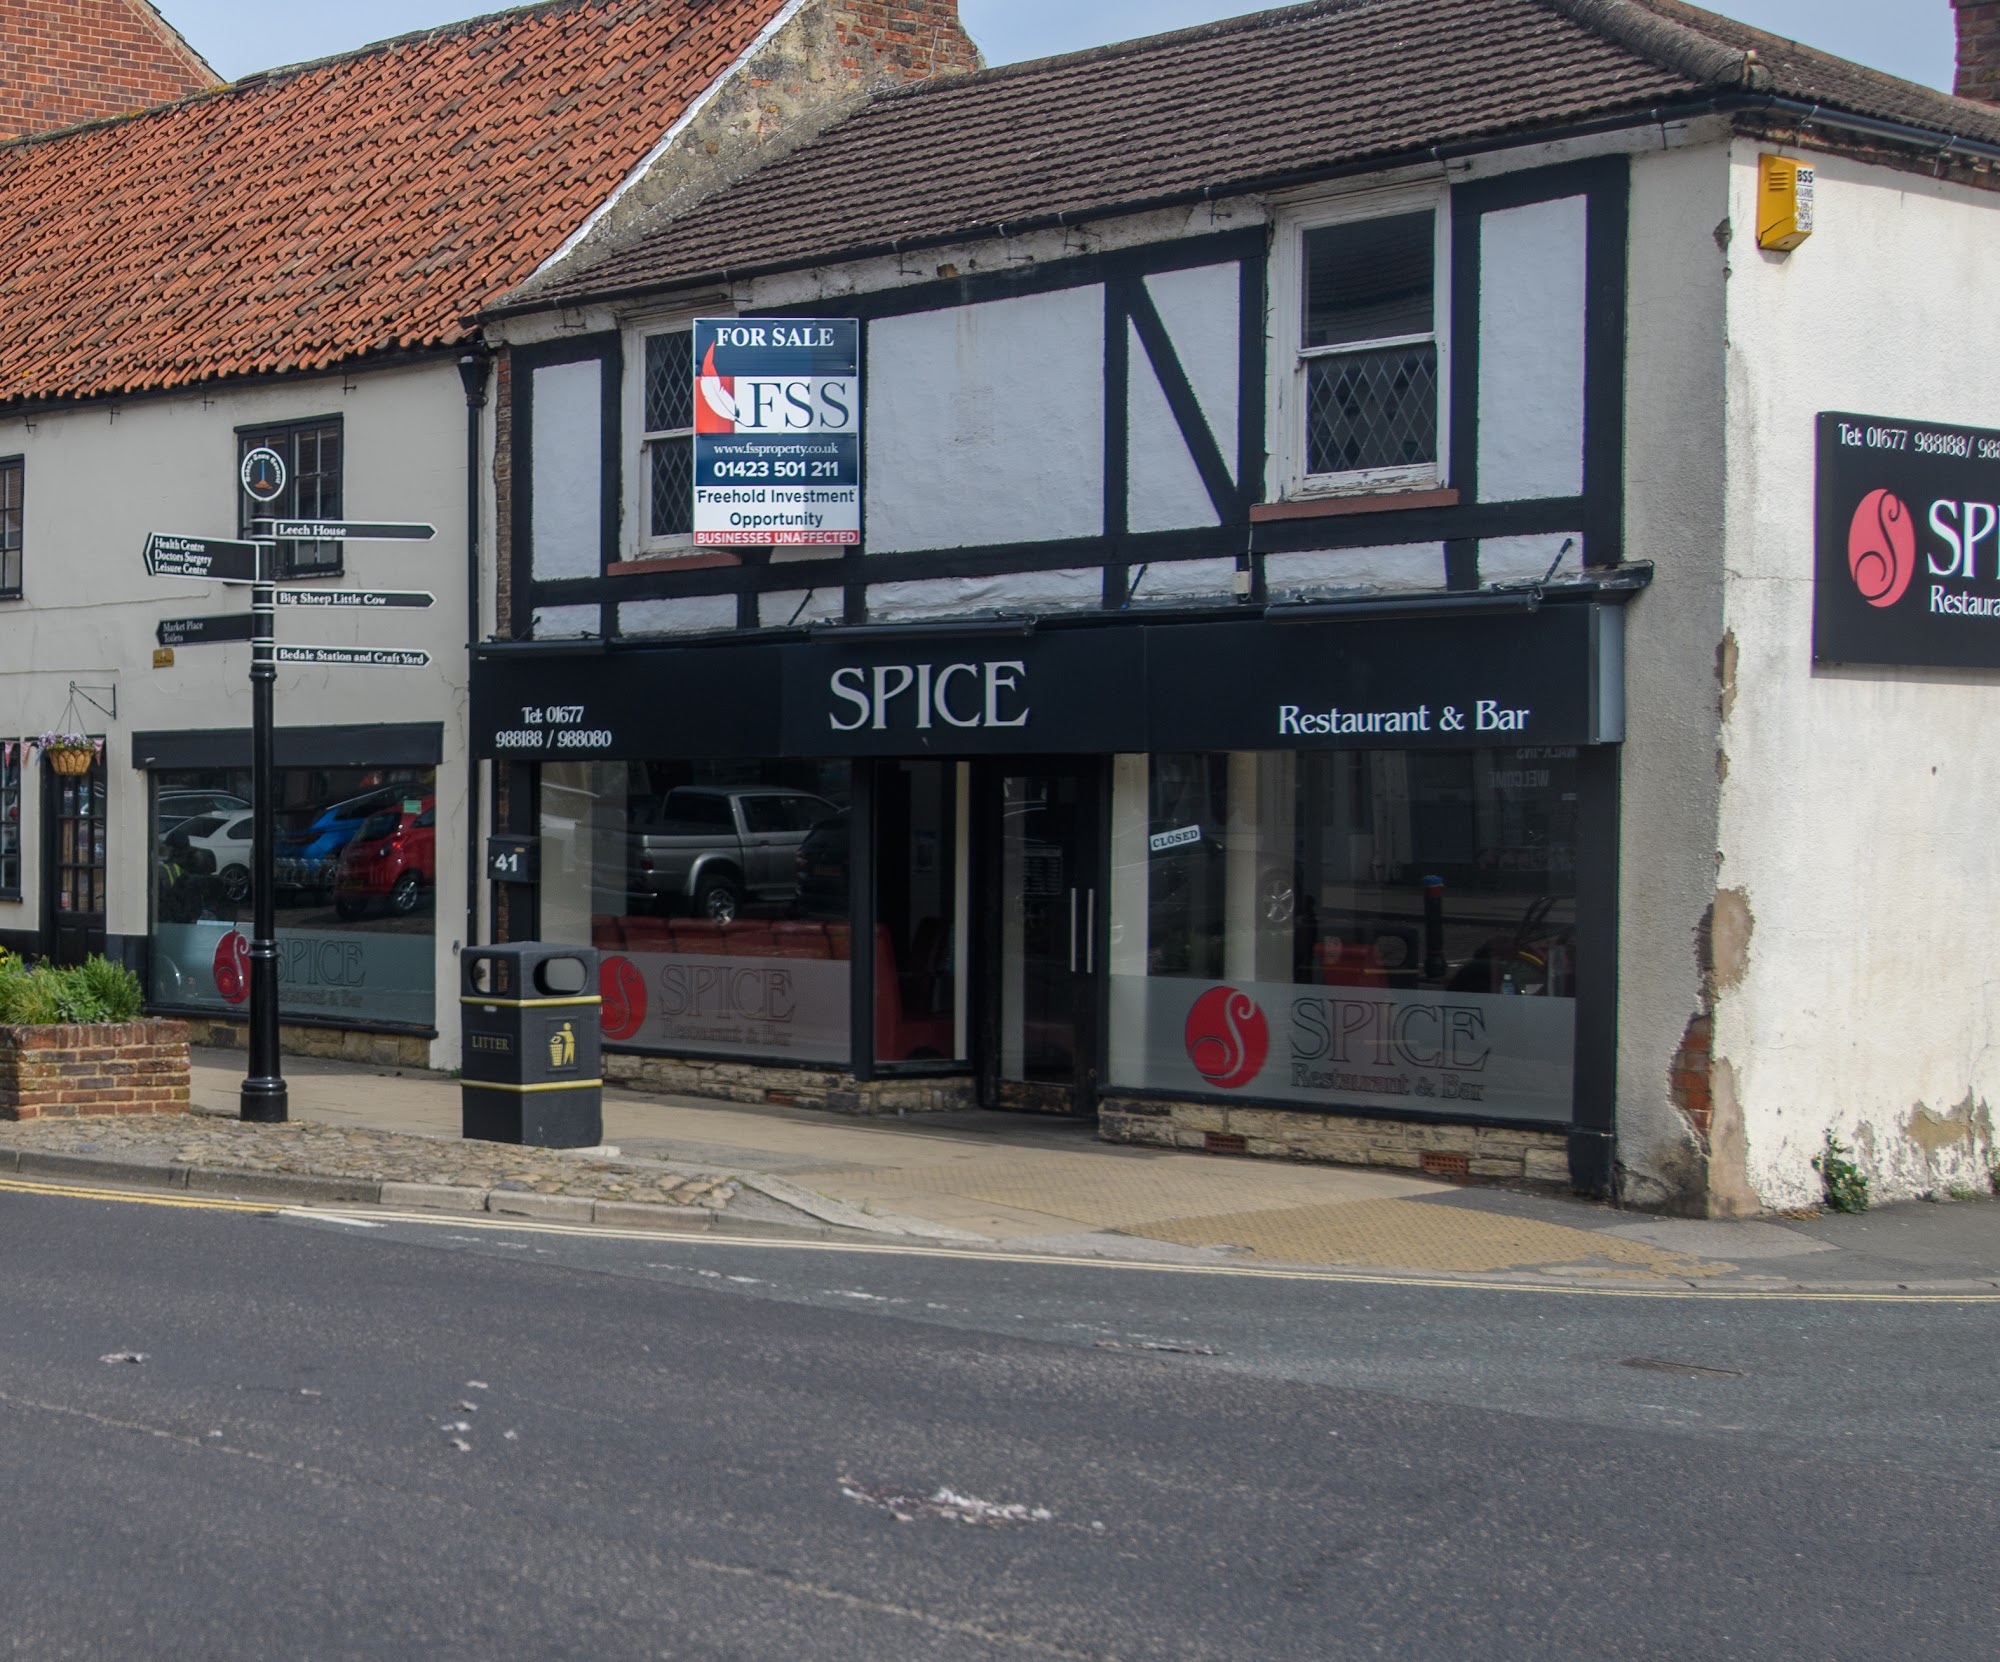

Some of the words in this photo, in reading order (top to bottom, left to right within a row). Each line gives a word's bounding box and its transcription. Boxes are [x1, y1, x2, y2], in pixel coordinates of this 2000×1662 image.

[1797, 169, 1813, 183] BSS
[716, 327, 767, 347] FOR
[772, 327, 835, 347] SALE
[747, 381, 849, 429] FSS
[1838, 423, 1863, 447] Tel:
[1866, 426, 1908, 450] 01677
[713, 442, 839, 457] www.fssproperty.co.uk
[713, 461, 769, 478] 01423
[774, 461, 806, 478] 501
[811, 461, 839, 477] 211
[697, 489, 766, 504] Freehold
[771, 488, 855, 503] Investment
[730, 512, 824, 528] Opportunity
[279, 524, 311, 536] Leech
[313, 525, 347, 536] House
[697, 532, 772, 544] BUSINESSES
[775, 531, 857, 544] UNAFFECTED
[155, 537, 180, 550] Health
[180, 539, 206, 553] Centre
[1927, 499, 2000, 580] SP
[155, 549, 184, 562] Doctors
[184, 551, 213, 568] Surgery
[155, 561, 182, 574] Leisure
[182, 563, 208, 575] Centre
[280, 592, 298, 605] Big
[300, 593, 332, 606] Sheep
[333, 593, 362, 604] Little
[363, 594, 387, 605] Cow
[1930, 584, 2000, 617] Restaura
[163, 621, 186, 632] Market
[186, 620, 204, 631] Place
[163, 633, 184, 643] Toilets
[280, 649, 315, 660] Bedale
[316, 650, 352, 661] Station
[353, 651, 372, 662] and
[373, 652, 400, 663] Craft
[401, 653, 424, 664] Yard
[828, 659, 1030, 731] SPICE
[545, 705, 585, 724] 01677
[1278, 704, 1431, 735] Restaurant
[1438, 706, 1465, 731] &
[1475, 699, 1530, 731] Bar
[495, 730, 543, 748] 988188
[557, 730, 612, 748] 988080
[1153, 829, 1198, 848] CLOSED
[494, 853, 518, 872] 41
[659, 963, 797, 1022] SPICE
[471, 1034, 510, 1052] LITTER
[1289, 996, 1491, 1073] SPICE
[1290, 1063, 1411, 1096] Restaurant
[1414, 1078, 1437, 1098] &
[1440, 1072, 1486, 1101] Bar
